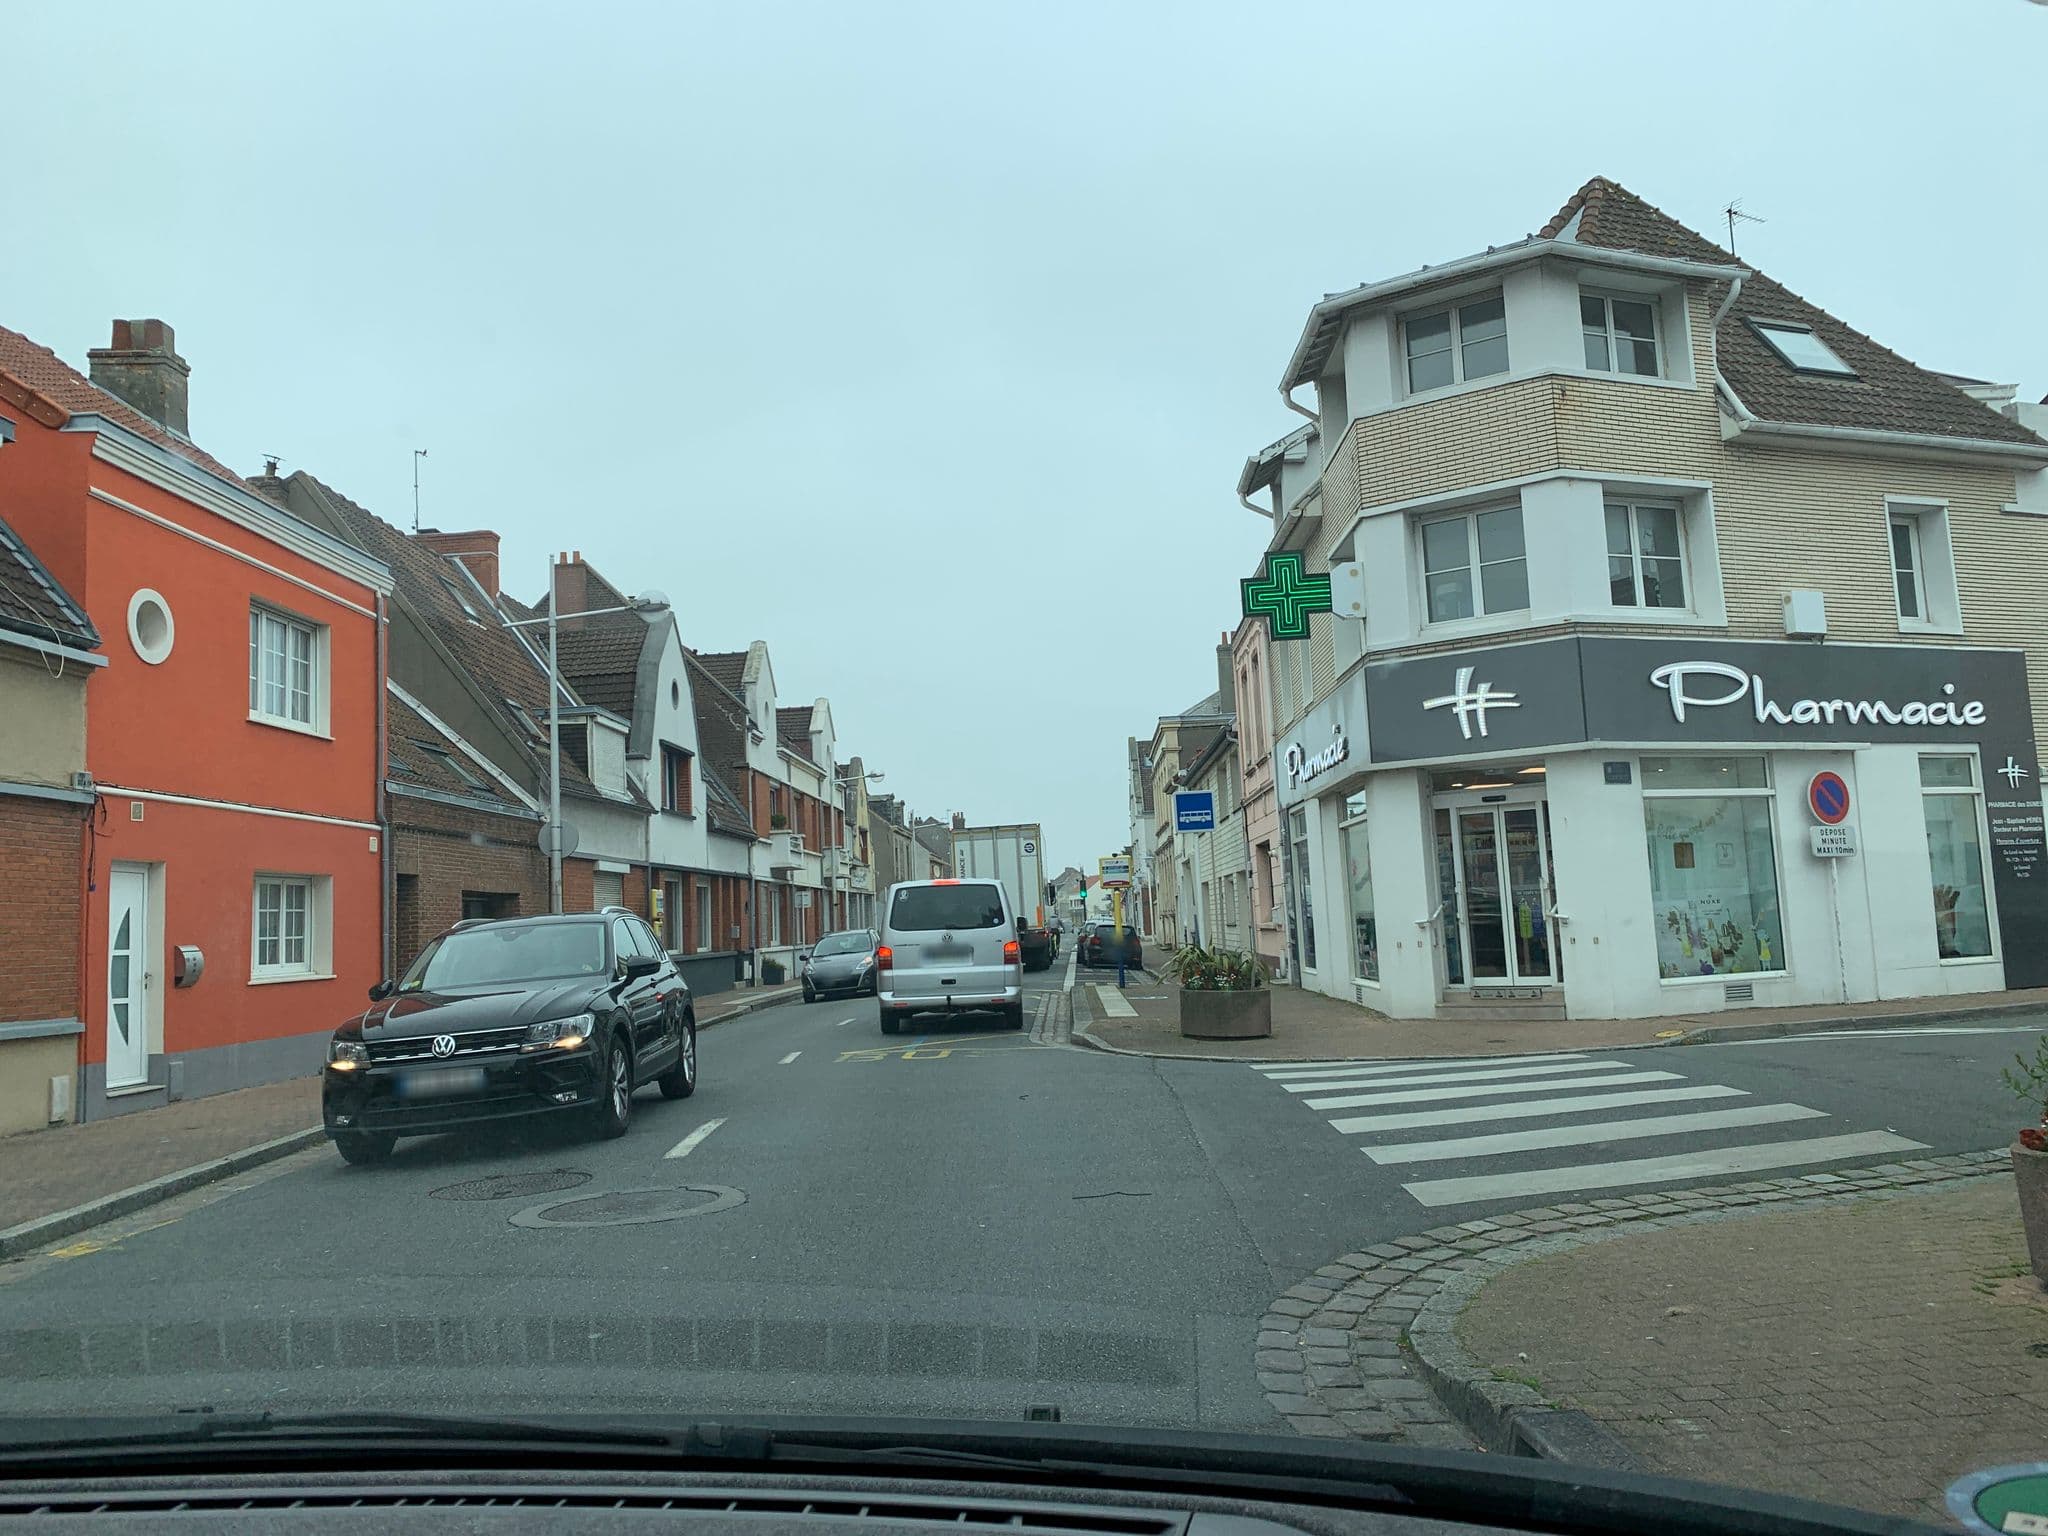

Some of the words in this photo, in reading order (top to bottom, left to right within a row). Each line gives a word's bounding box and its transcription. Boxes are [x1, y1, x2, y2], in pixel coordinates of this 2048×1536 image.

[1651, 661, 1986, 725] Pharmacie
[1284, 724, 1348, 790] Pharmacie
[1816, 846, 1833, 854] MAXI
[1835, 846, 1854, 854] 10min
[1821, 837, 1847, 845] MINUTE
